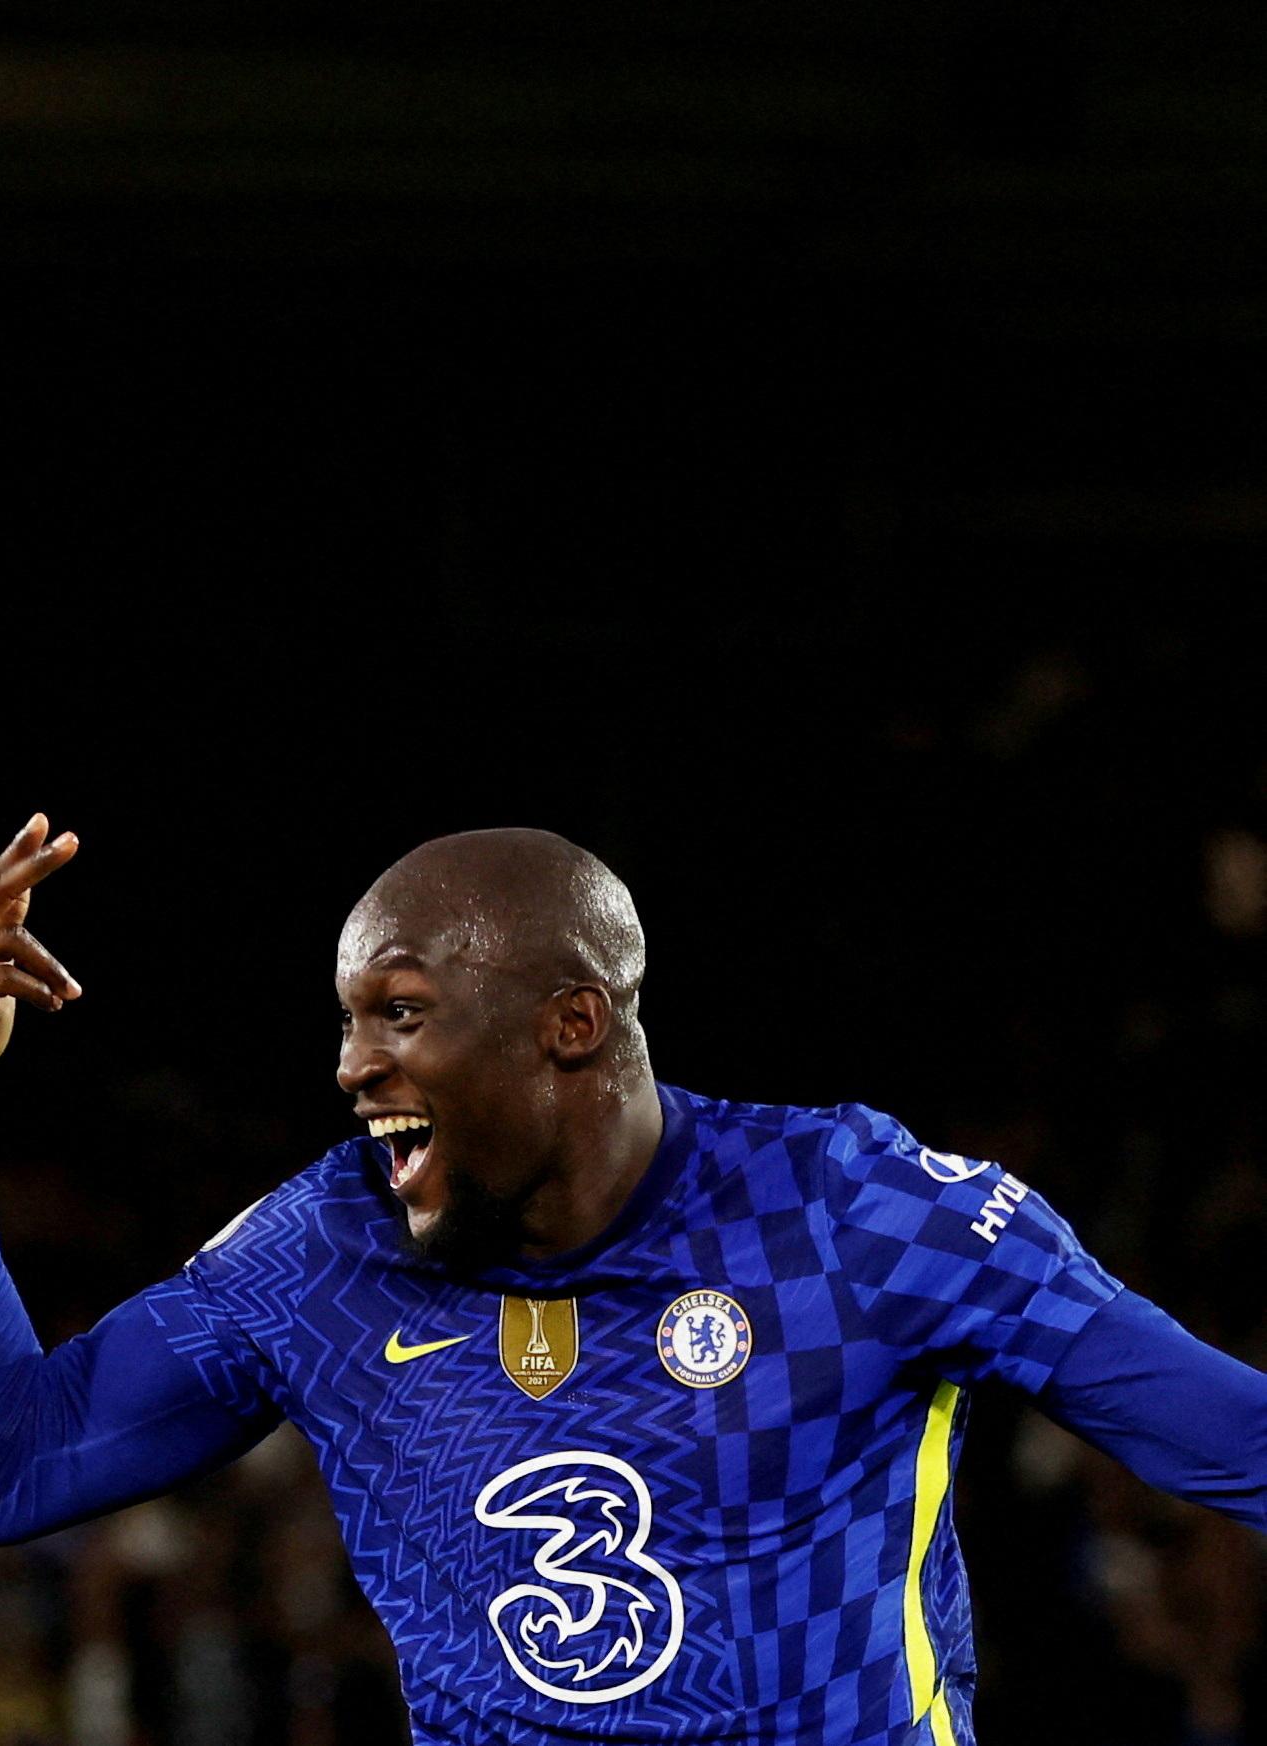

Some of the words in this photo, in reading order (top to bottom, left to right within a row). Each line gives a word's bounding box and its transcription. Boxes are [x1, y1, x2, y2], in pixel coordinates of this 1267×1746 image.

[672, 1294, 732, 1317] CHELSEA
[521, 1356, 555, 1370] FIFA
[527, 1376, 548, 1385] 2021
[675, 1366, 716, 1383] FOOTBALL
[474, 1450, 684, 1704] 3
